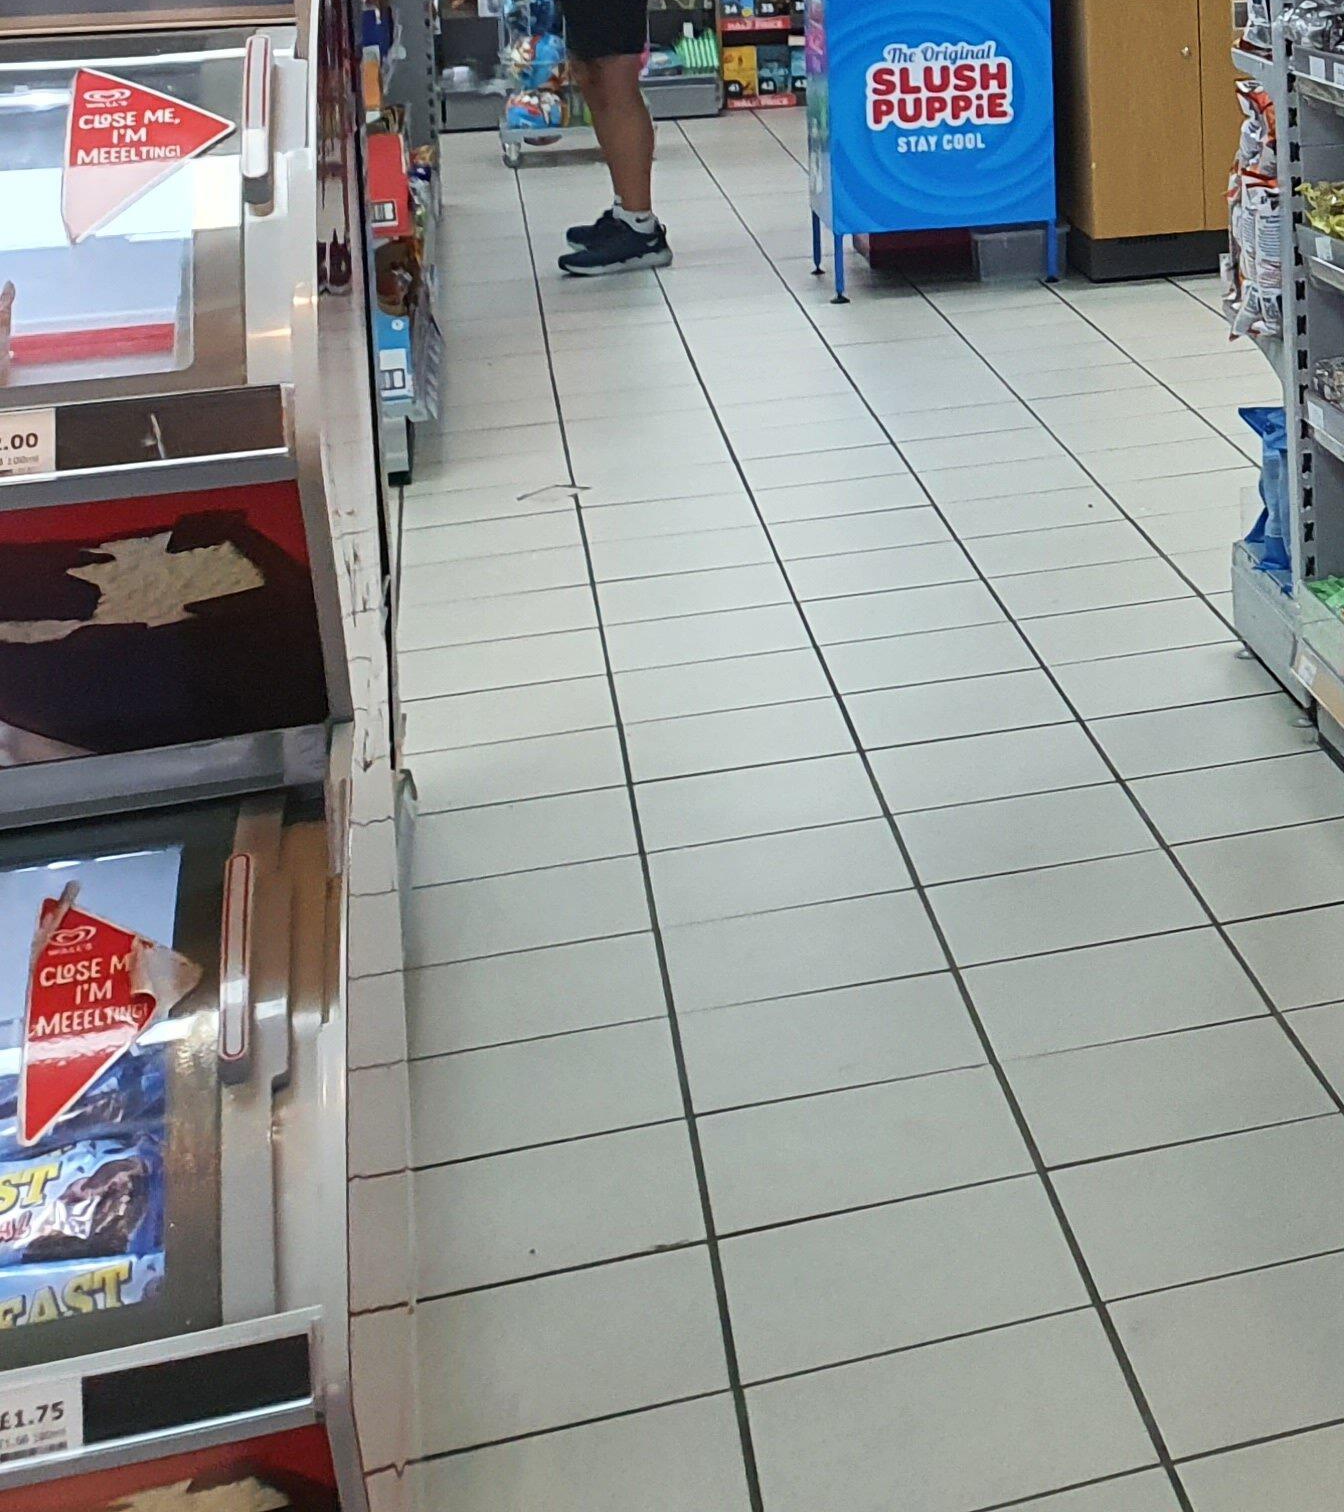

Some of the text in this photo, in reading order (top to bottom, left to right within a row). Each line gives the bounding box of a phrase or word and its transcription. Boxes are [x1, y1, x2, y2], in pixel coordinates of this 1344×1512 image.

[887, 44, 993, 65] The Original
[871, 62, 1007, 96] SLUSH
[79, 108, 181, 128] CLOSE ME,
[112, 127, 147, 144] I'M
[897, 133, 986, 153] STAY COOL
[76, 145, 181, 165] MEEELTING!
[40, 963, 102, 987] CLOSE
[74, 984, 112, 1004] I'M
